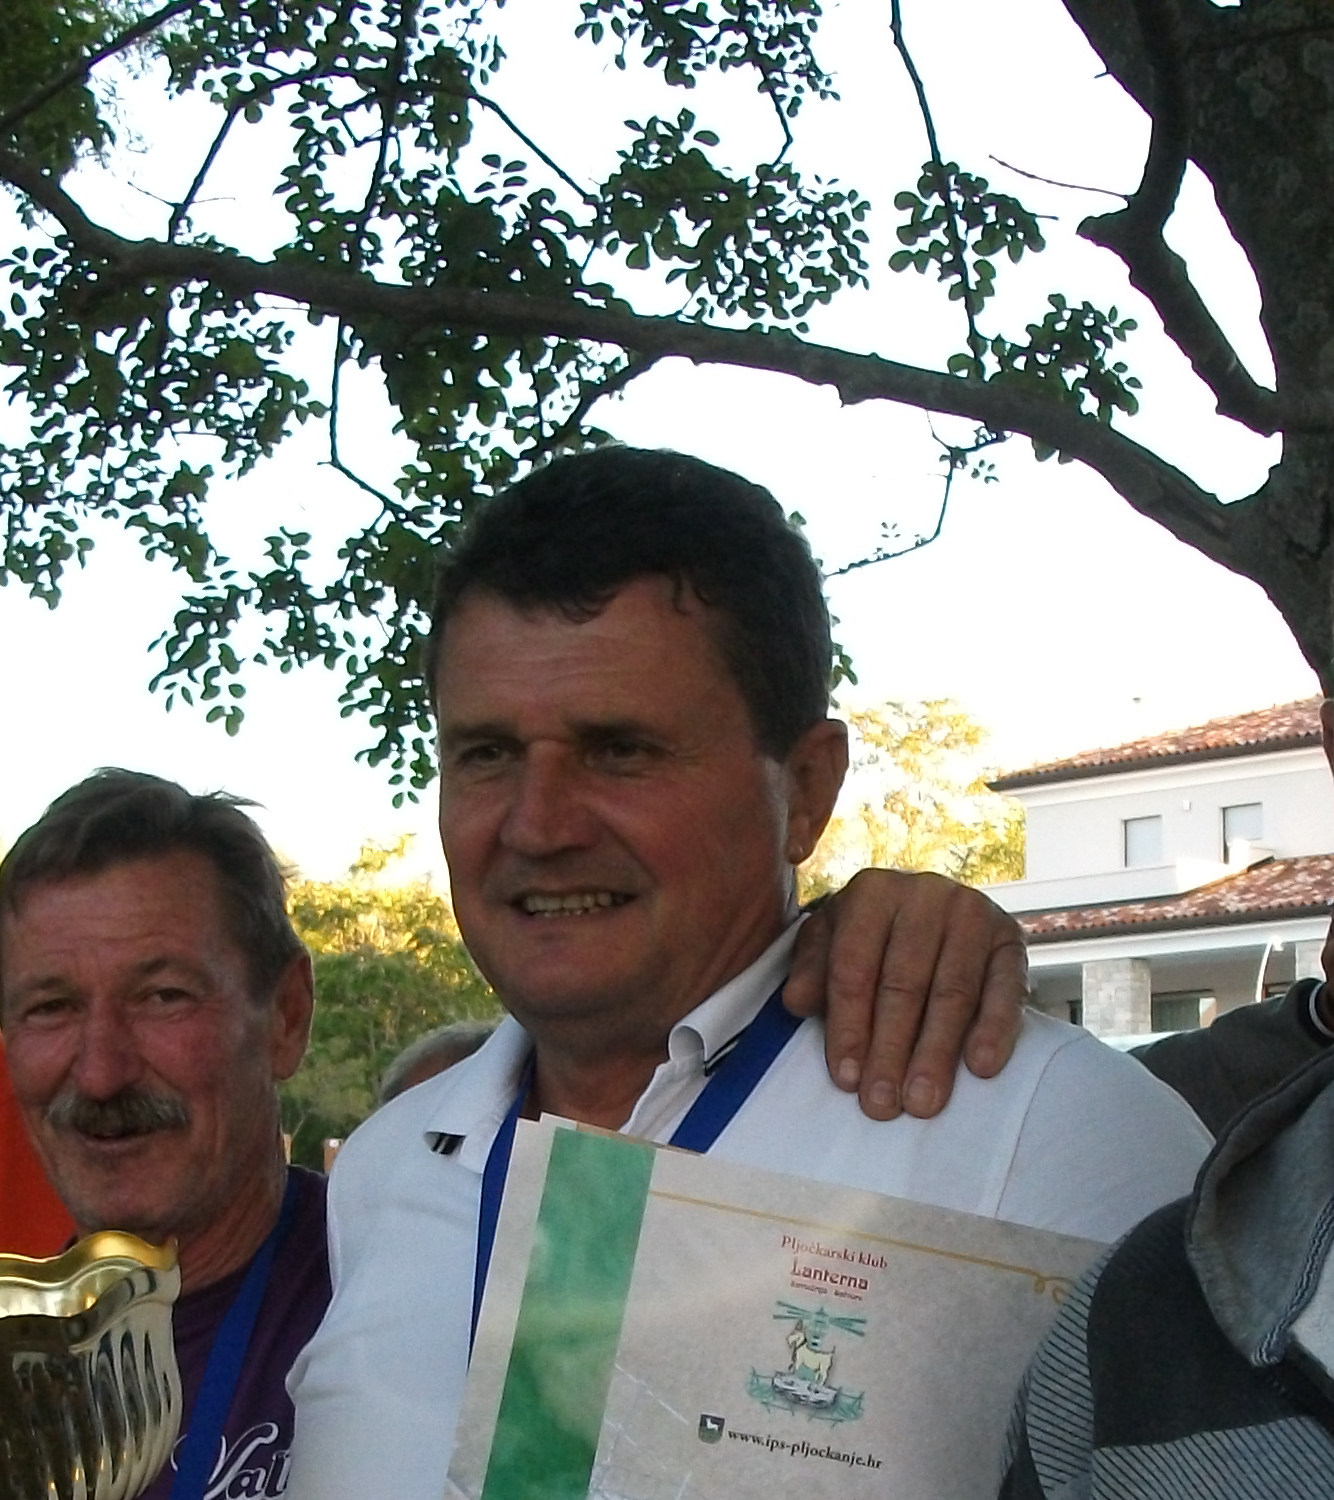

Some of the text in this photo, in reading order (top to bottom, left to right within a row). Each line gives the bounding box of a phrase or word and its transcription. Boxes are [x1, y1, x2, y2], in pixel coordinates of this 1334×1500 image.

[790, 1257, 869, 1290] Lanterna
[858, 1252, 888, 1269] klub
[727, 1430, 883, 1469] www.ips-pljockanje.hr
